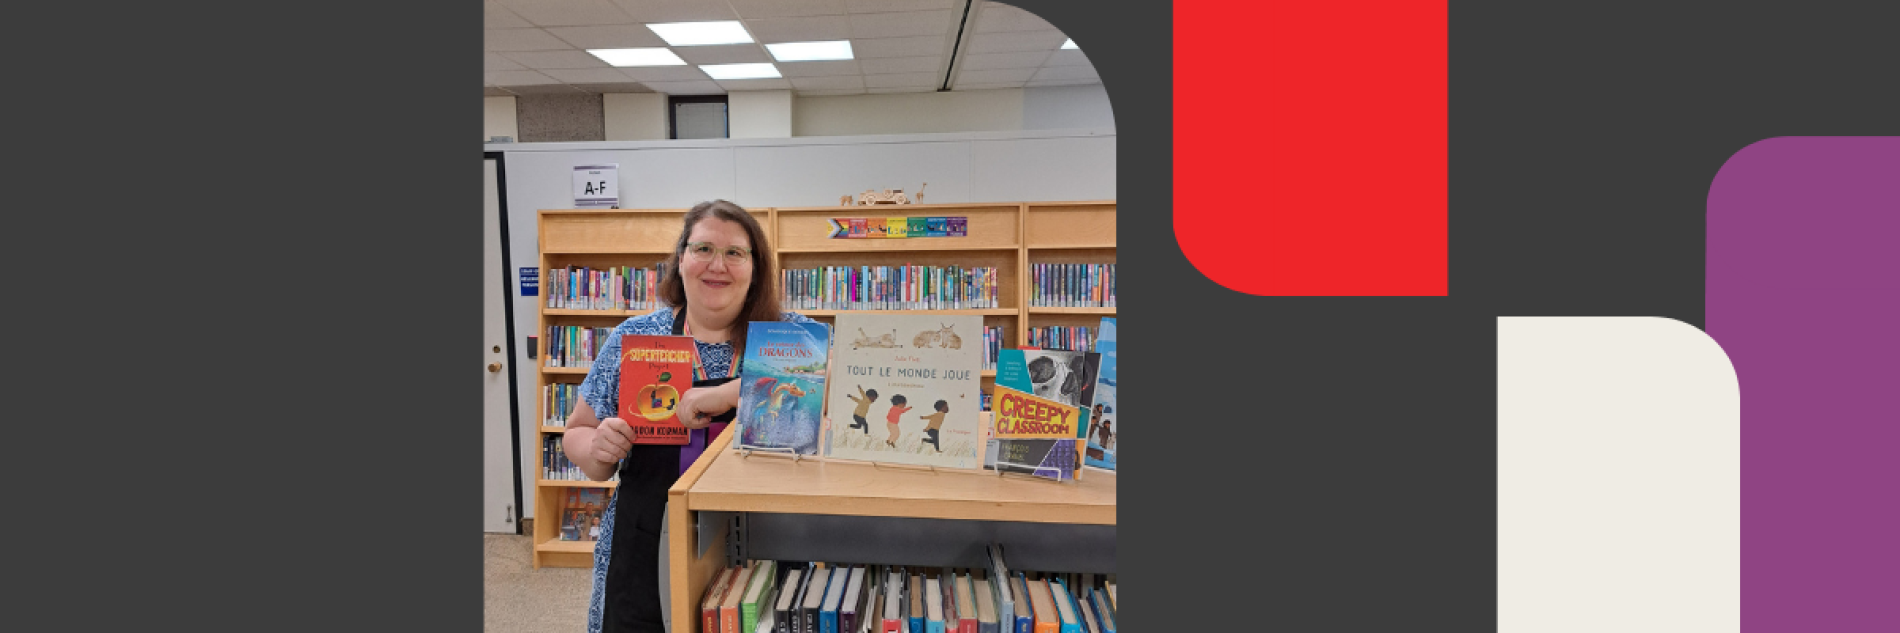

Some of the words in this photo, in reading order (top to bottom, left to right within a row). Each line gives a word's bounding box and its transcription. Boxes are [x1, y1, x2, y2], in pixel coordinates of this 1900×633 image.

[584, 181, 606, 195] A-F
[630, 348, 690, 363] SUPERTEACHER
[758, 347, 813, 358] DRAGONS
[847, 365, 873, 376] TOUT
[880, 367, 892, 378] LE
[898, 368, 937, 379] MONDE
[942, 370, 970, 381] JOUE
[1000, 393, 1071, 424] CREEPY
[630, 426, 654, 435] RDON
[657, 426, 688, 436] KORMAN
[998, 417, 1070, 434] CLASSROOM
